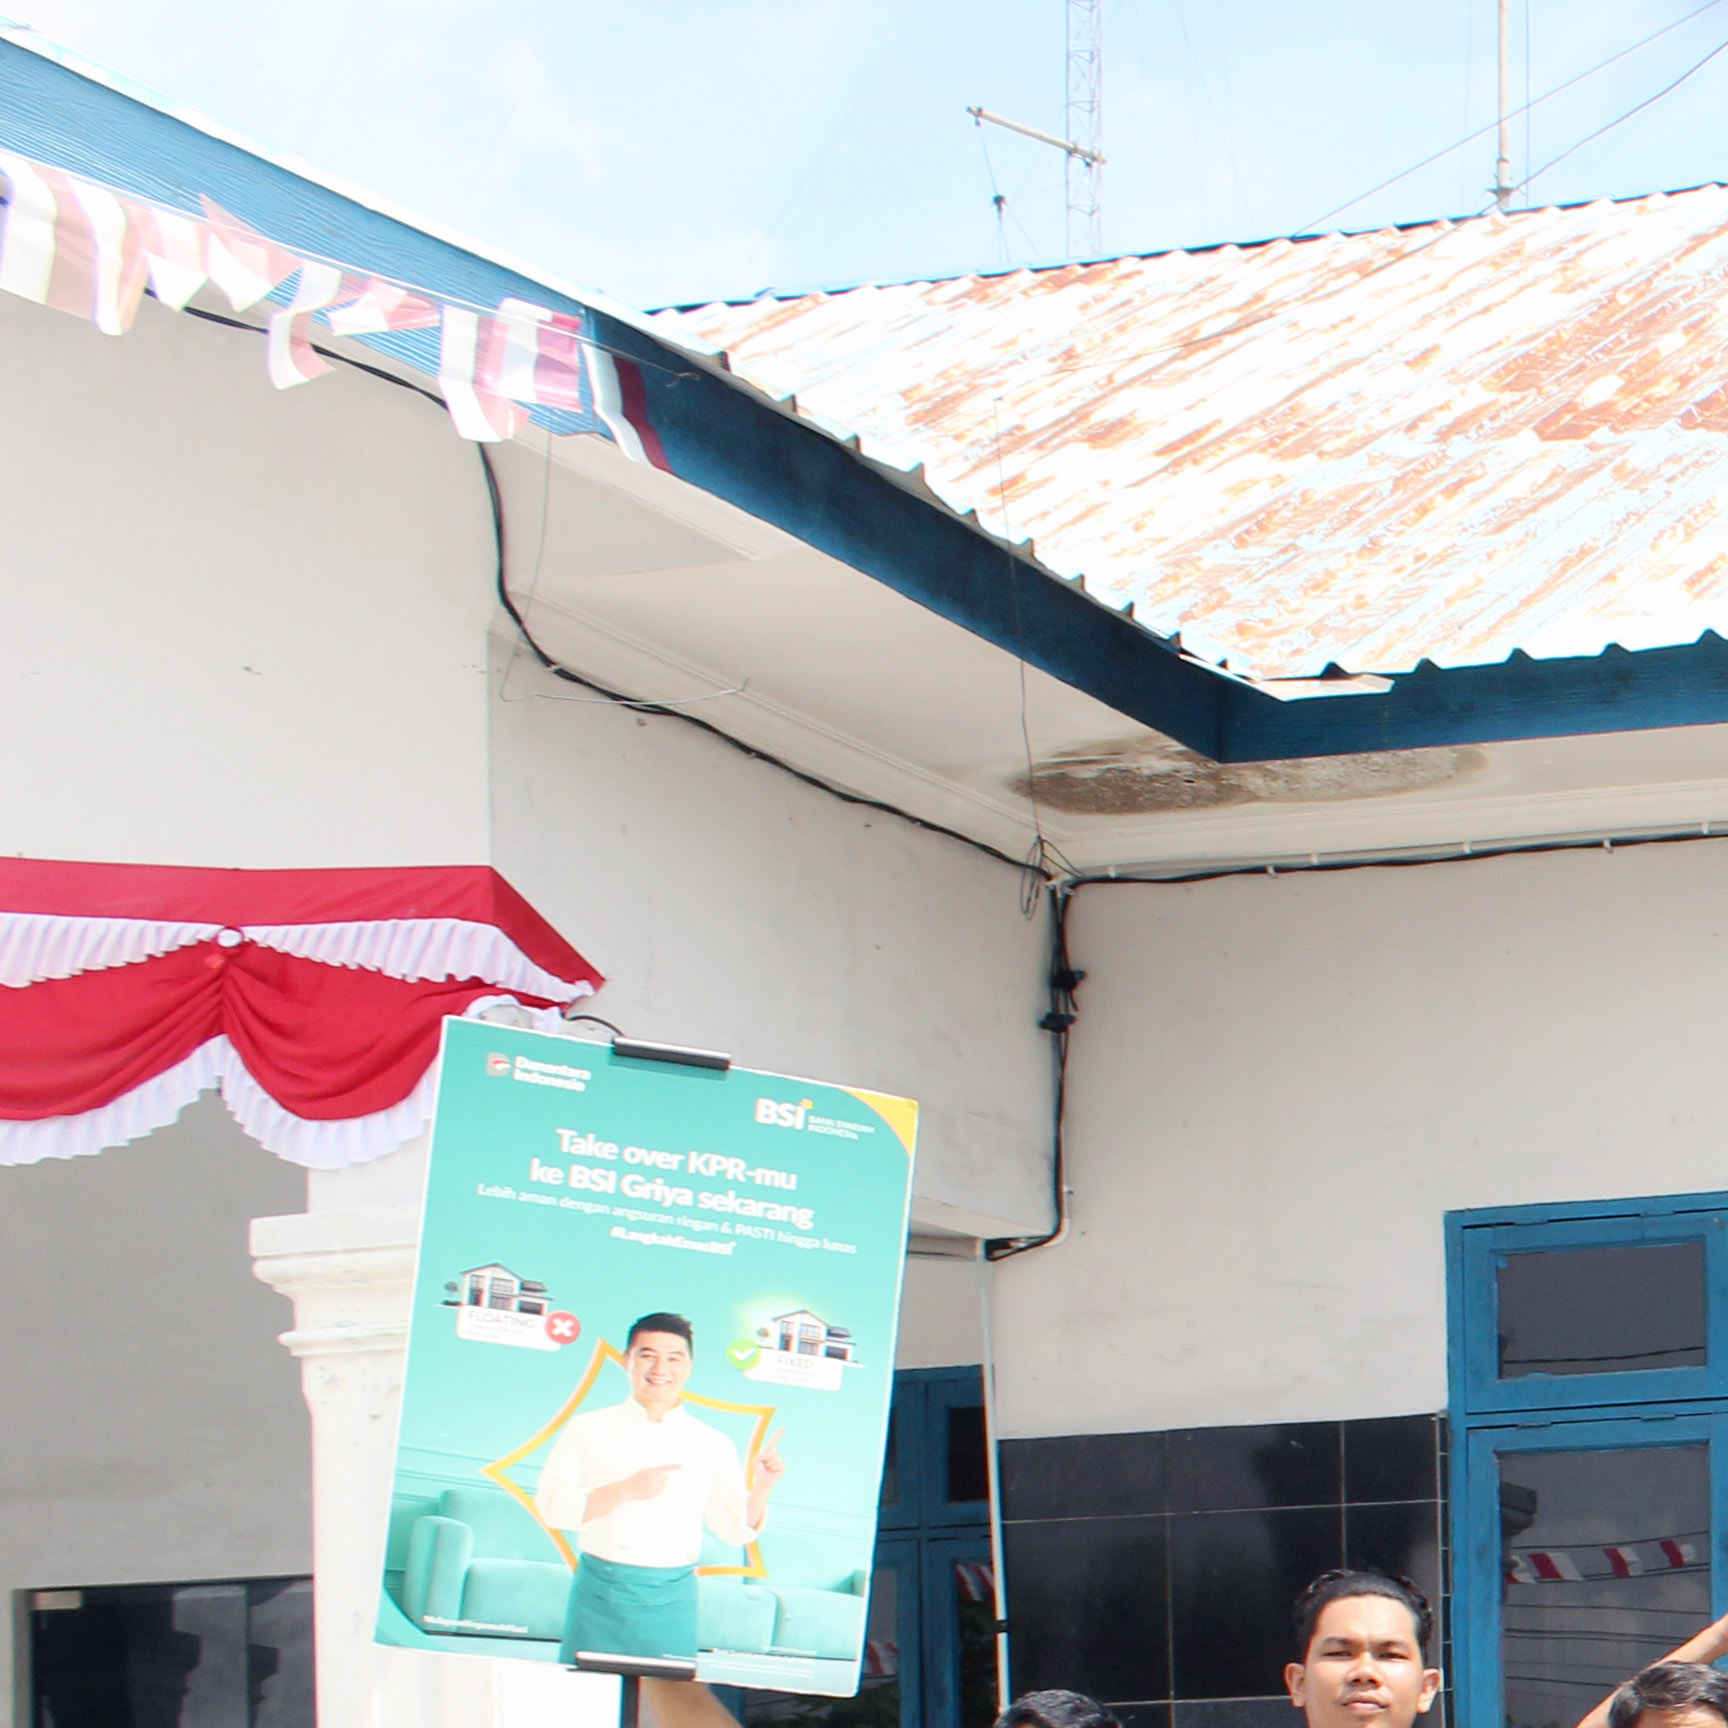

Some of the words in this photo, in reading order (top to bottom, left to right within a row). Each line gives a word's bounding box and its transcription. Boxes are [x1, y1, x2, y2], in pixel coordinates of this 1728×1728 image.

[754, 1097, 805, 1130] BSI
[555, 1128, 618, 1160] Take
[622, 1146, 684, 1170] over
[686, 1150, 798, 1190] KPR-mu
[530, 1158, 565, 1186] ke
[568, 1164, 618, 1194] BSI
[620, 1174, 694, 1208] Griya
[697, 1190, 816, 1231] sekarang
[477, 1183, 517, 1200] Lebih
[518, 1192, 558, 1206] aman
[559, 1196, 610, 1214] dengan
[612, 1206, 675, 1225] angsuran
[676, 1214, 718, 1232] ringan
[720, 1221, 732, 1234] &
[734, 1223, 776, 1241] PASTI
[776, 1230, 822, 1250] hingga
[822, 1238, 858, 1254] lunas
[468, 1310, 536, 1329] FLOATING
[778, 1355, 816, 1368] FIXED
